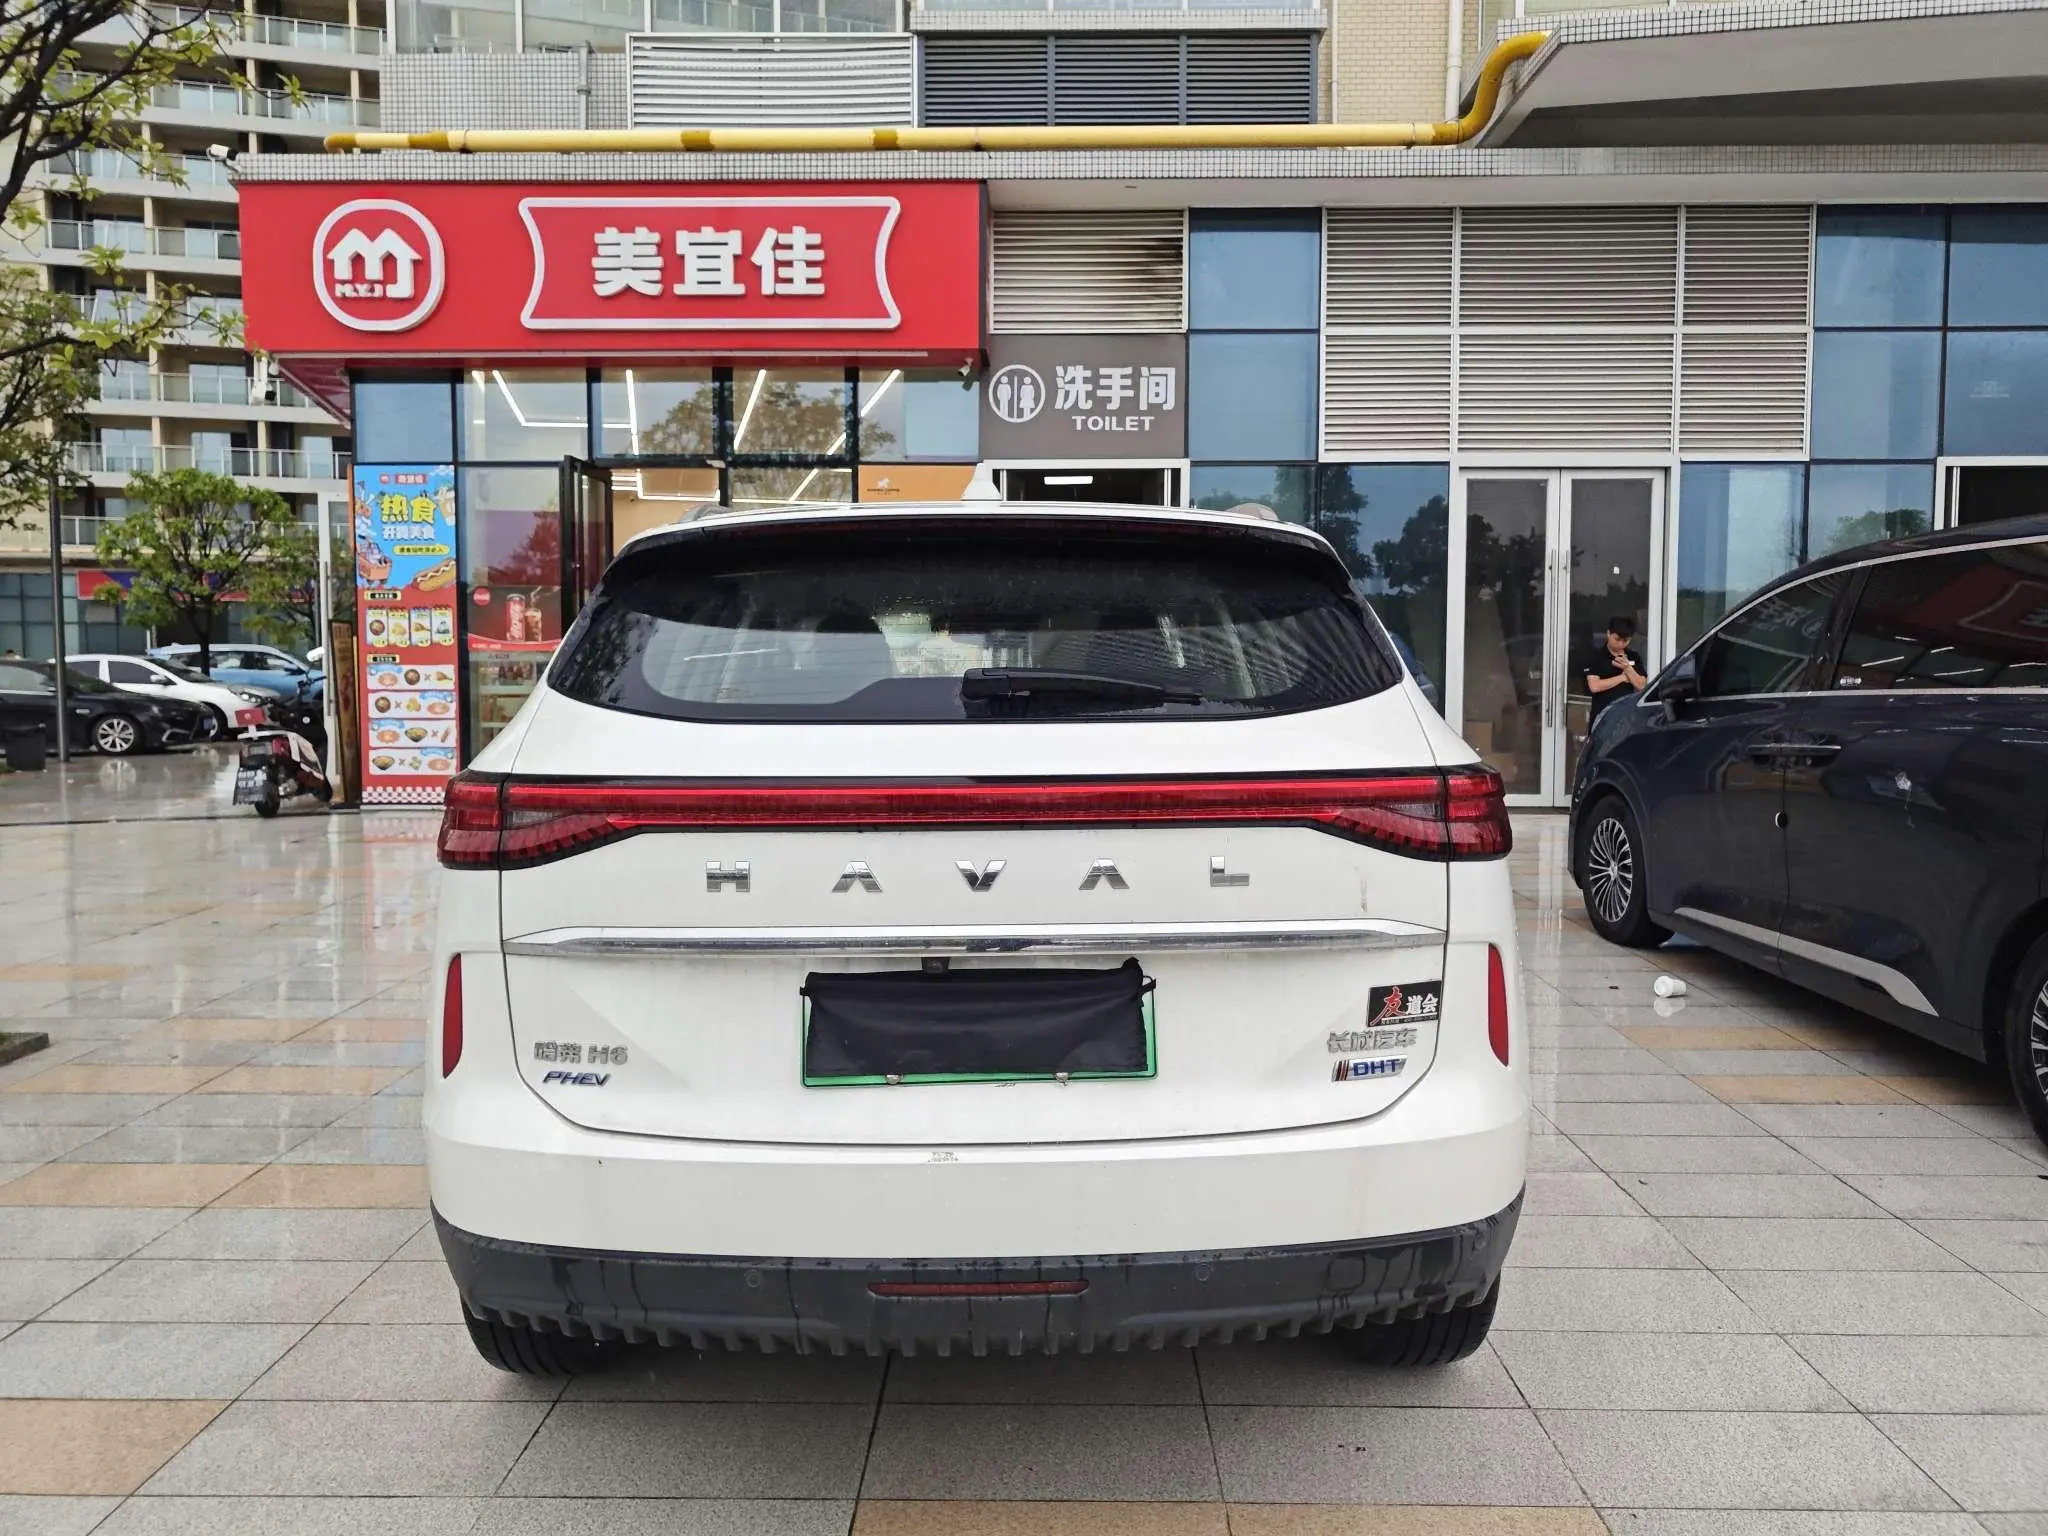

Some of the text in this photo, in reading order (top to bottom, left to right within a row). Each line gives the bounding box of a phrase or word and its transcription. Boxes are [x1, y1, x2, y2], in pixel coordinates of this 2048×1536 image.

[592, 226, 825, 297] 美宜佳
[1054, 365, 1176, 410] 洗手间
[1072, 415, 1155, 431] TOILET
[380, 493, 437, 525] 热食
[706, 856, 1251, 893] HAVAL
[1327, 1028, 1419, 1053] 长城汽车
[587, 1045, 628, 1065] H6
[1353, 1058, 1400, 1077] DHT
[542, 1070, 611, 1087] PHEV
